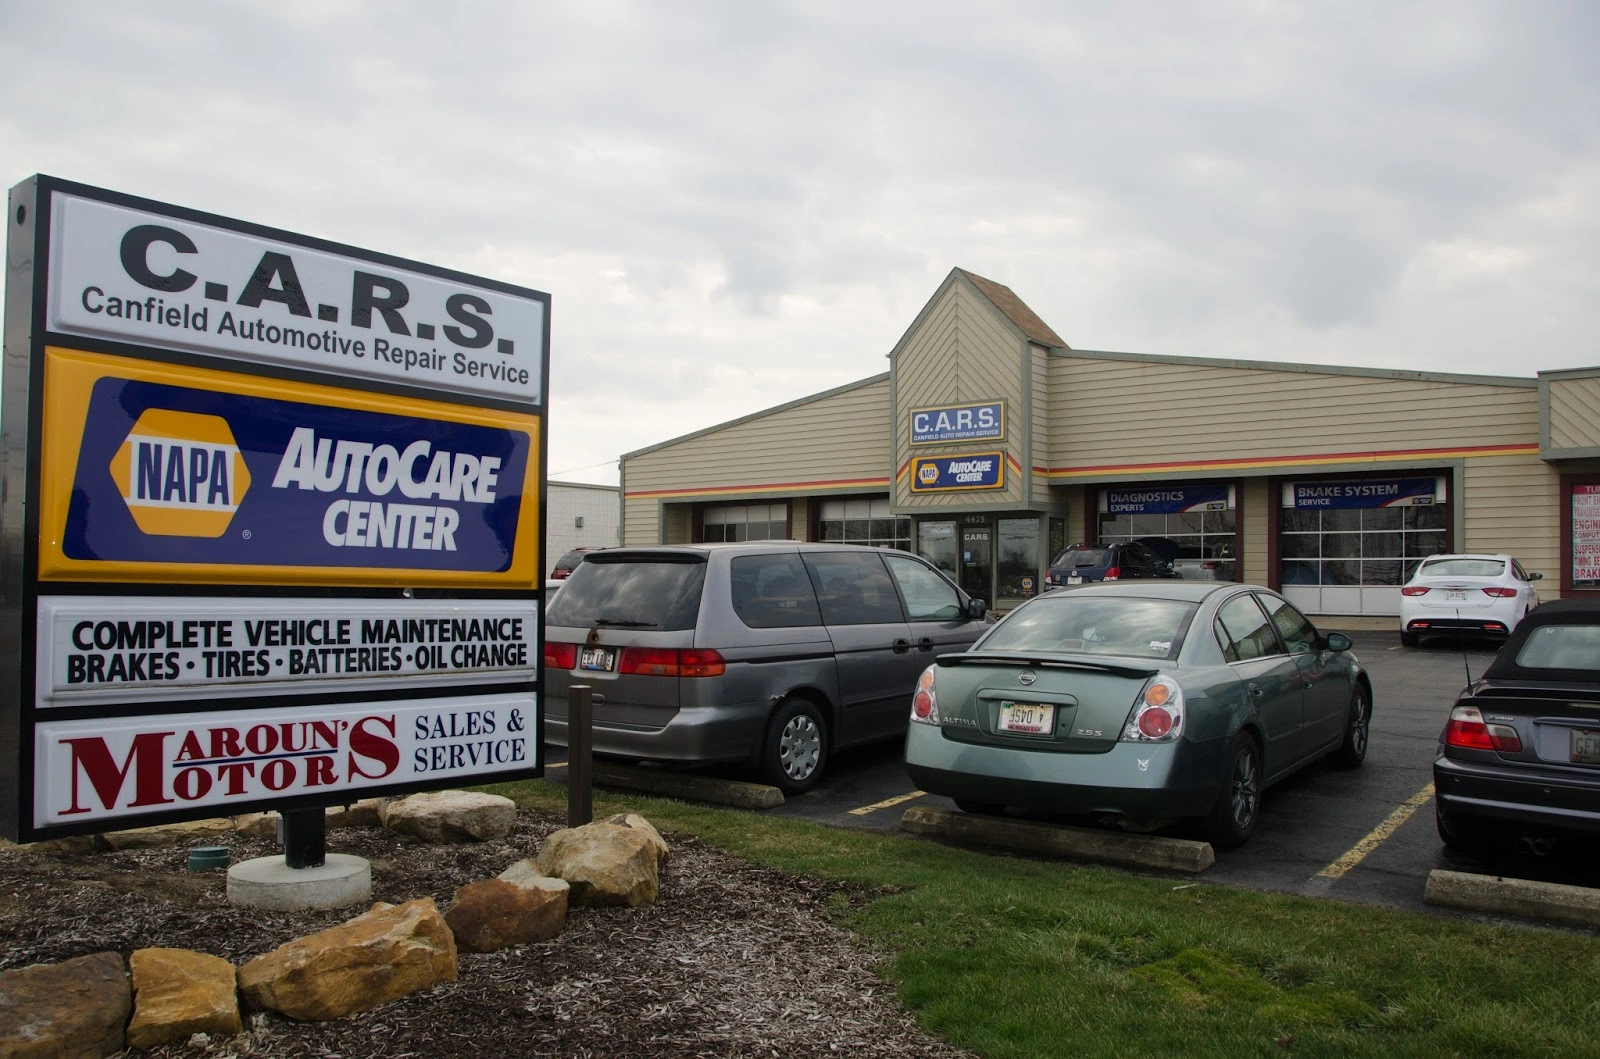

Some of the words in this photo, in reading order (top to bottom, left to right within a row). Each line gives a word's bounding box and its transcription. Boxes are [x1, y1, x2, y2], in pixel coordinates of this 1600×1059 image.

[119, 224, 515, 355] C.A.R.S.
[81, 285, 209, 332] Canfield
[217, 311, 366, 359] Automotive
[374, 340, 447, 371] Repair
[452, 352, 530, 385] Service
[914, 407, 999, 433] C.A.R.S.
[913, 433, 939, 441] CANFIELD
[137, 441, 231, 506] NAPA
[921, 468, 936, 479] NAPA
[956, 472, 983, 483] CENTER
[1110, 491, 1184, 503] DIAGNOSTICS
[1298, 485, 1341, 498] BRAKE
[1345, 484, 1399, 496] SYSTEM
[1298, 498, 1331, 507] SERVICE
[1574, 496, 1592, 505] FRONT
[1110, 503, 1144, 512] EXPERTS
[322, 499, 460, 551] CENTER
[965, 515, 985, 523] 4475
[1574, 520, 1600, 530] ENGIN
[72, 620, 233, 652] COMPLETE
[244, 619, 351, 647] VEHICLE
[361, 618, 523, 645] MAINTENANCE
[67, 651, 180, 684] BRAKES
[202, 649, 270, 679] TIRES
[289, 646, 402, 675] BATTERIES
[415, 644, 448, 670] OIL
[450, 643, 527, 668] CHANGE
[414, 711, 496, 741] SALES
[506, 708, 525, 732] &
[942, 716, 976, 726] ALTIMA
[413, 738, 526, 773] SERVICE
